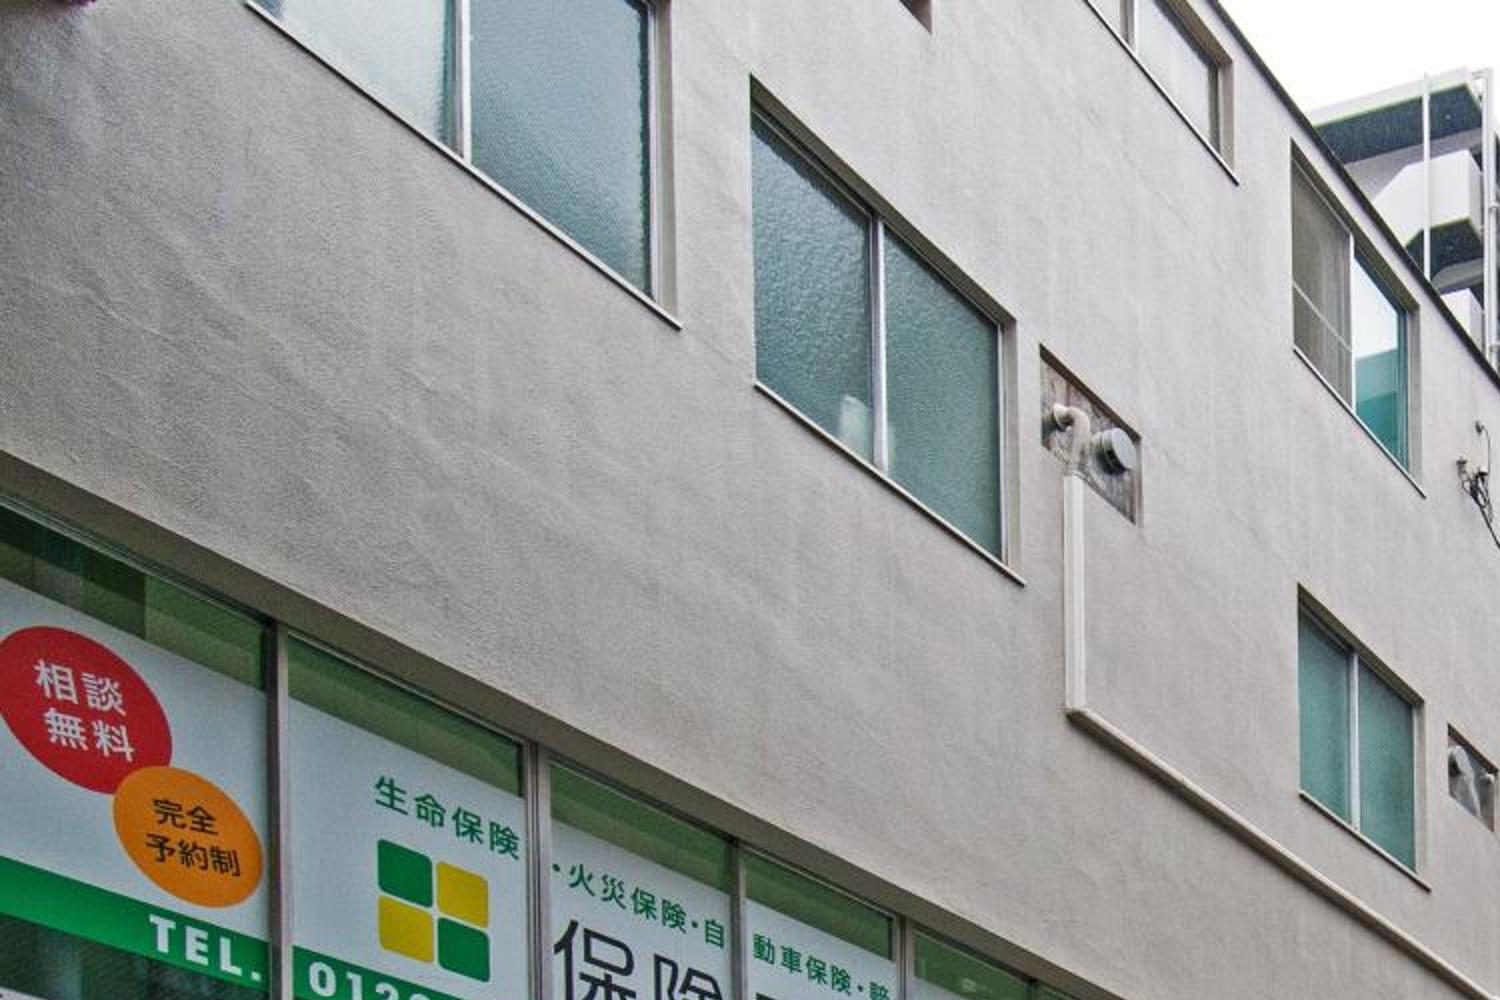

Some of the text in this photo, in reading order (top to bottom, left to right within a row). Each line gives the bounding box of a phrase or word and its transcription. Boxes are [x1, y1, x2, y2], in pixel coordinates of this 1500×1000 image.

[34, 660, 128, 717] 相談
[42, 707, 136, 763] 無料
[152, 798, 219, 837] 完全
[145, 834, 240, 878] 予約制
[148, 914, 263, 983] TEL.
